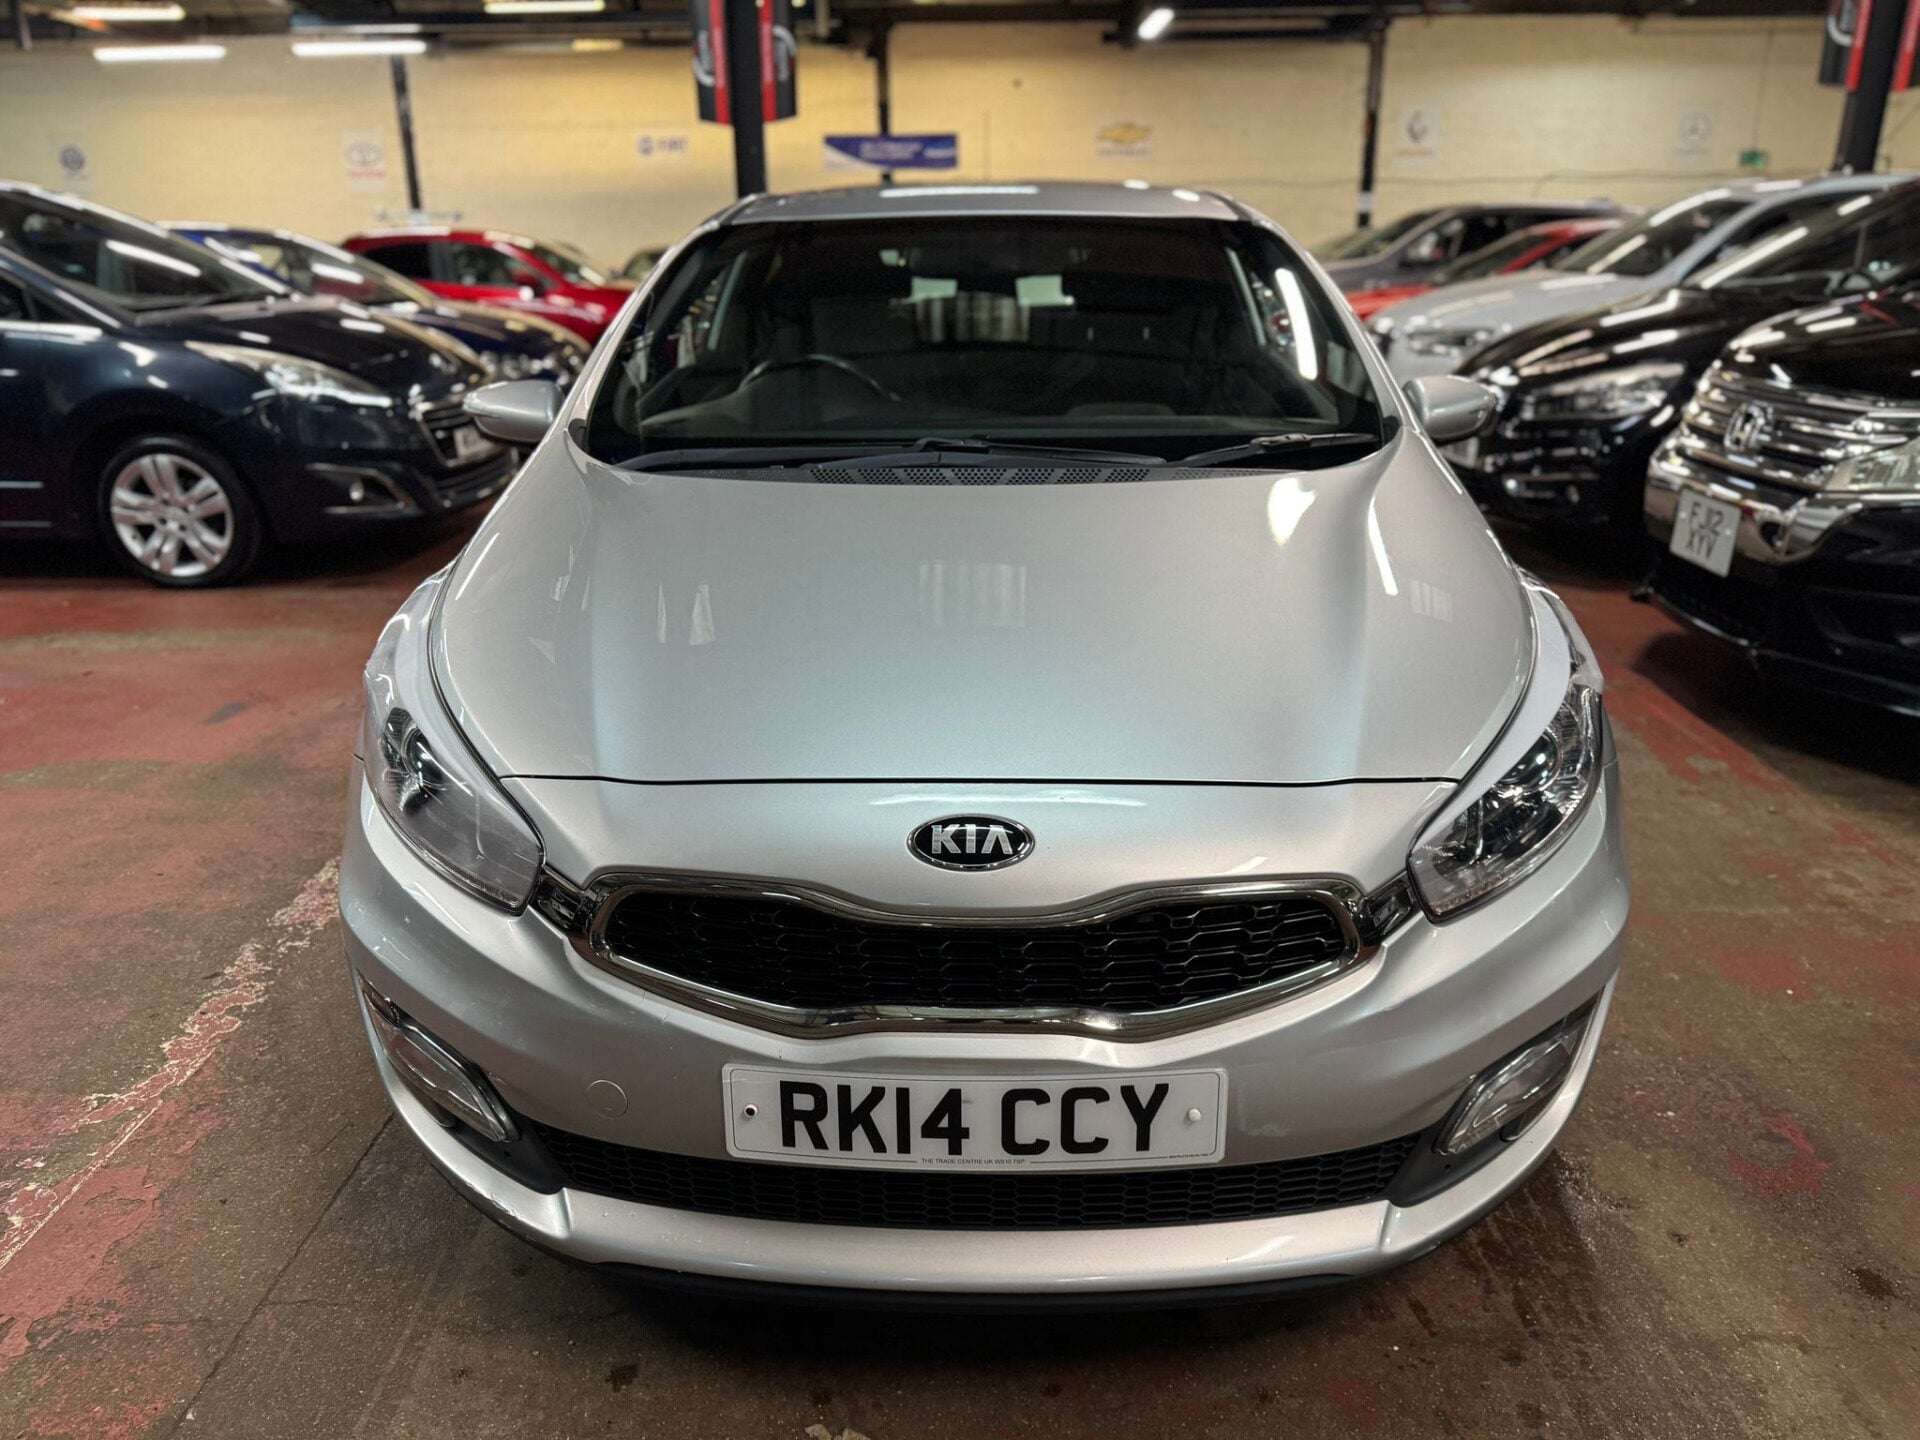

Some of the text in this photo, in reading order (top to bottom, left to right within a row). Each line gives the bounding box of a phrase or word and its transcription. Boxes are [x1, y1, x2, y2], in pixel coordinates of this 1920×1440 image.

[931, 823, 1014, 855] KIA
[779, 1079, 1170, 1156] RK14 CCY
